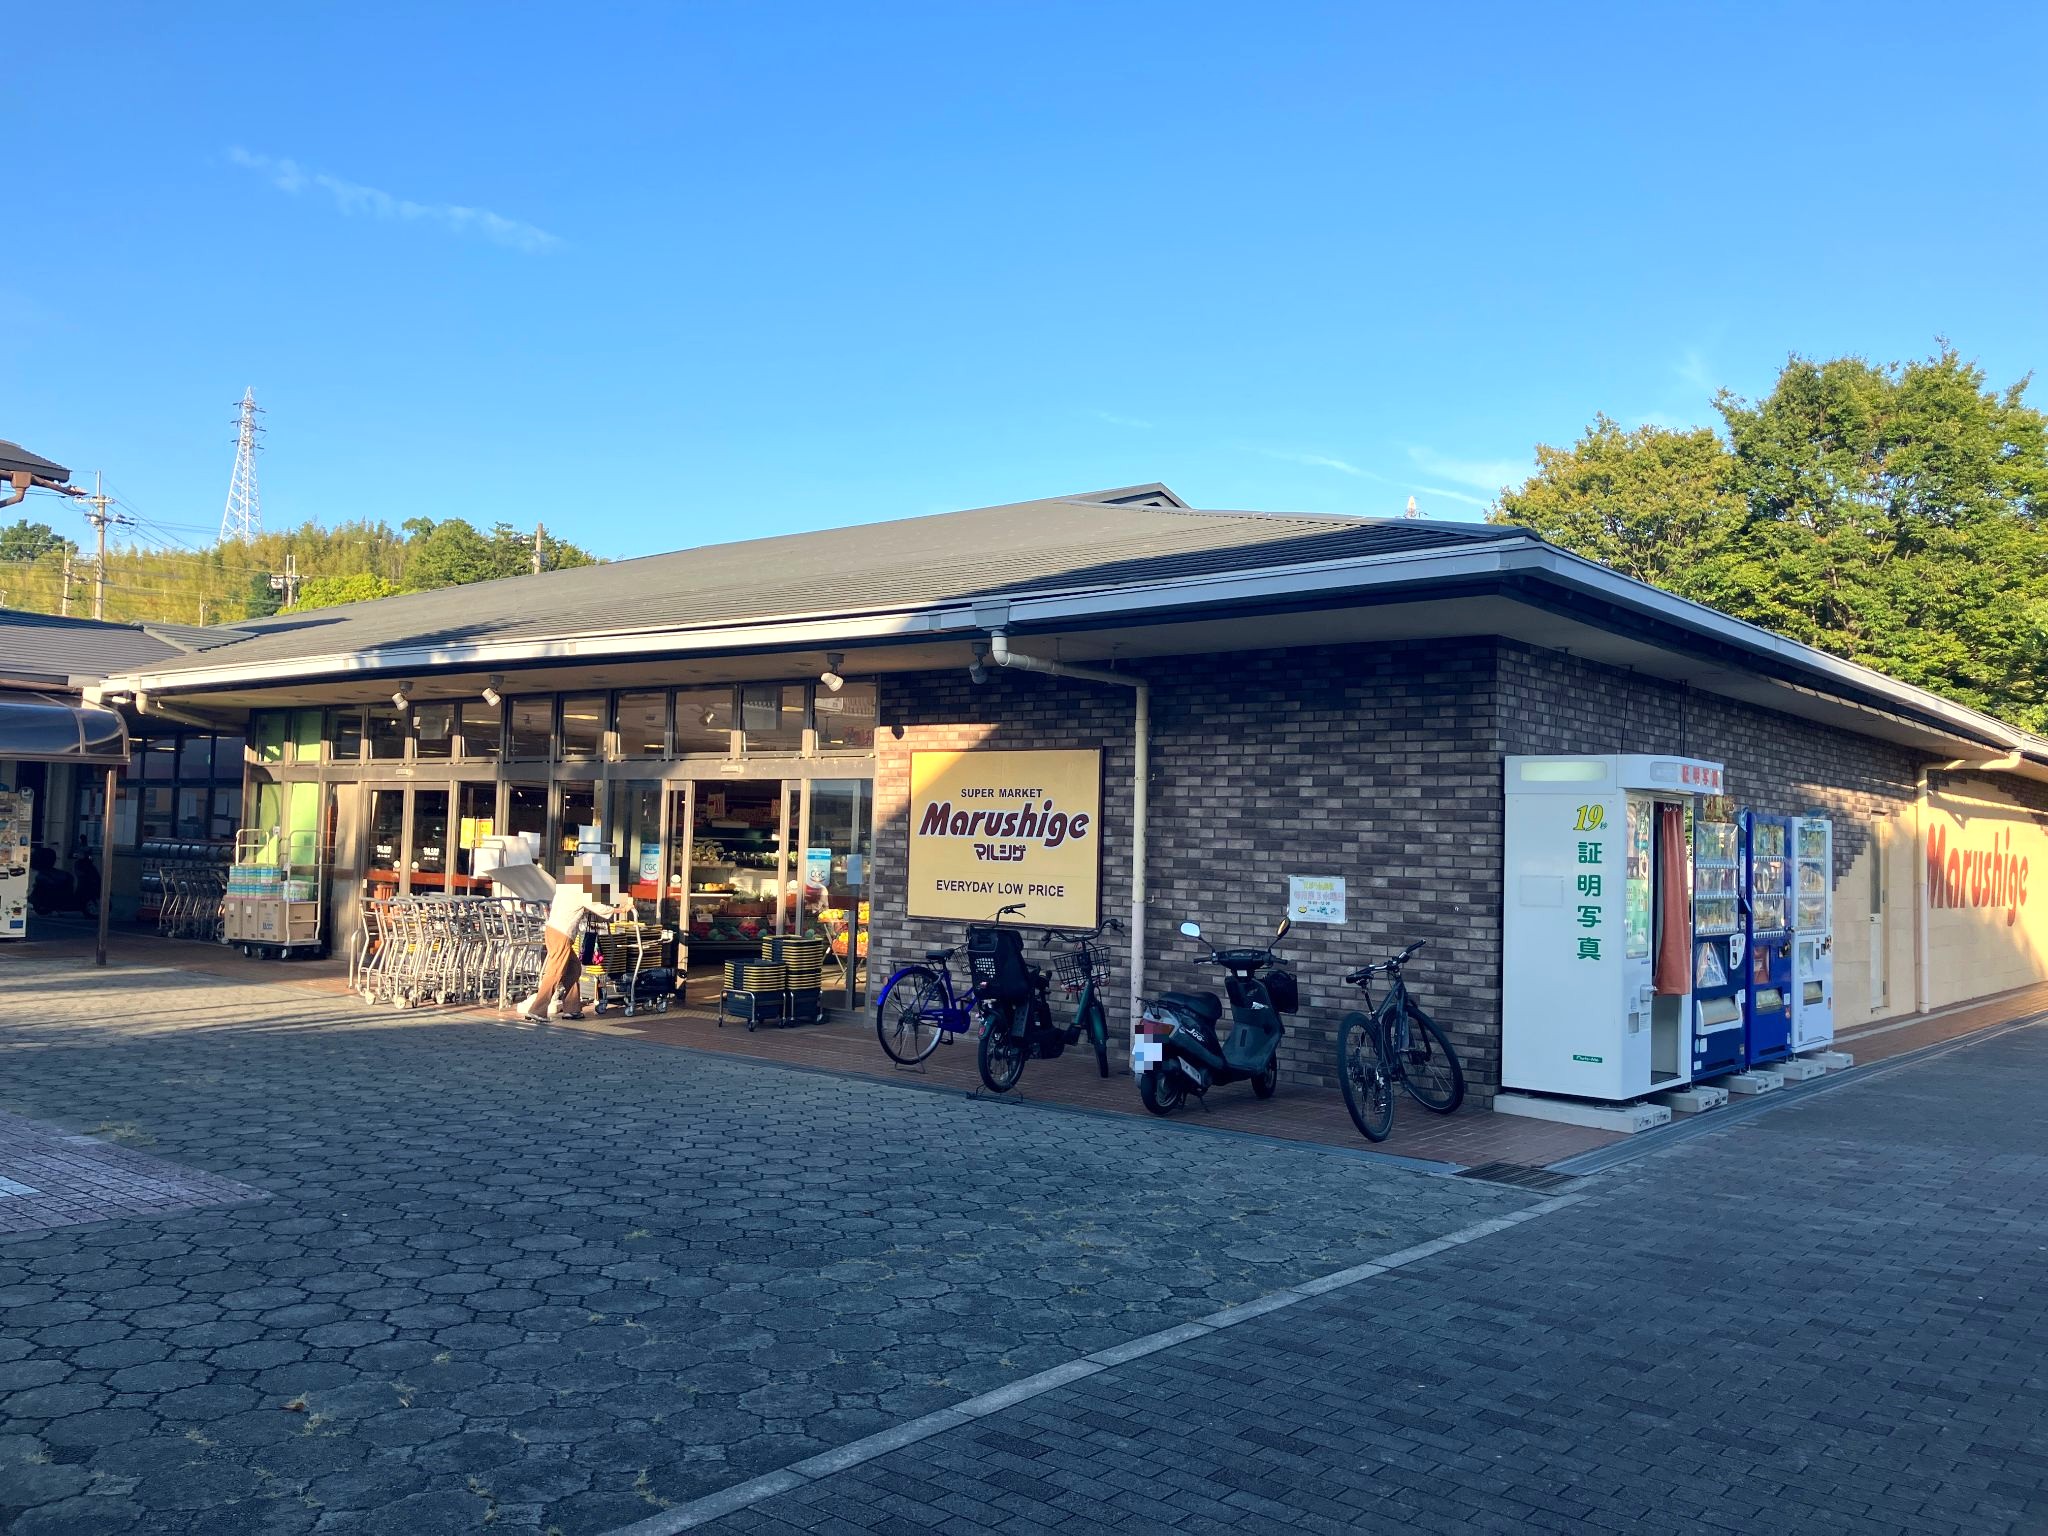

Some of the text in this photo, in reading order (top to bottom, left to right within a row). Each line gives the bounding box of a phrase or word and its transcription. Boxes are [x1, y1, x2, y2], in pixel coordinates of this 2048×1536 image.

[961, 788, 1043, 798] SUPER MARKET
[919, 799, 1090, 847] Marushige
[973, 843, 1027, 862] マルシゲ
[644, 863, 657, 871] CGC
[810, 870, 826, 879] CGC
[1927, 822, 2029, 927] Marushige
[936, 880, 1065, 897] EVERYDAY LOW PRICE
[1577, 841, 1603, 961] 証明写真
